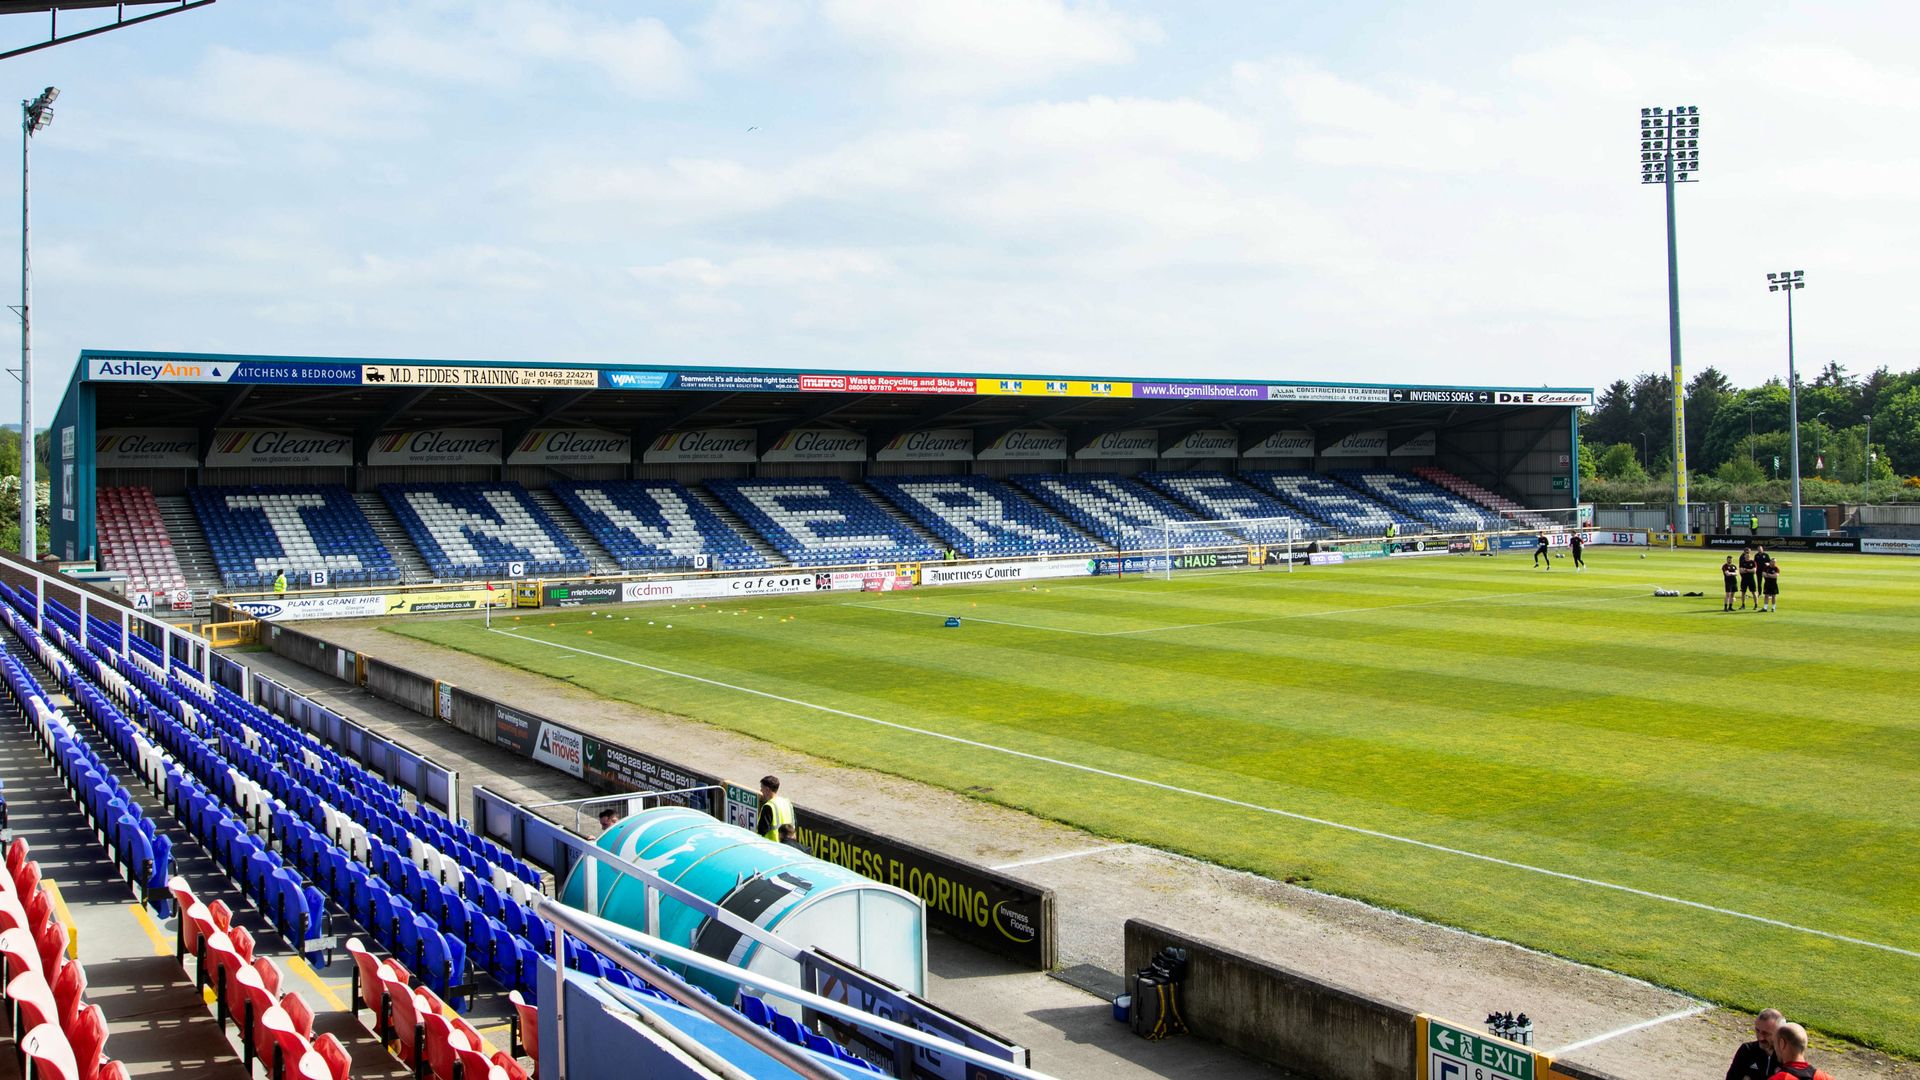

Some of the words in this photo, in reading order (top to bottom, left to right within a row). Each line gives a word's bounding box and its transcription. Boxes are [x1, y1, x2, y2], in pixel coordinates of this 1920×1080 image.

[99, 362, 200, 379] AshleyAnn
[238, 367, 289, 379] KITCHENS
[292, 368, 298, 378] &
[302, 368, 356, 379] BEDROOMS
[389, 368, 413, 383] M.D.
[418, 368, 460, 384] FIDDES
[463, 369, 519, 384] TRAINING
[803, 377, 844, 388] munros
[850, 377, 876, 385] Waste
[878, 378, 918, 387] Recycling
[937, 379, 954, 387] Skip
[1142, 384, 1258, 397] www.kingsmillshotel.com
[1410, 391, 1450, 401] INVERNESS
[1451, 392, 1474, 402] SOFAS
[1501, 394, 1534, 403] D&E
[251, 432, 350, 455] Gleaner
[410, 430, 500, 454] Gleaner
[546, 431, 628, 454] Gleaner
[678, 431, 754, 453] Gleaner
[799, 431, 865, 452] Gleaner
[906, 432, 969, 451] Gleaner
[1004, 432, 1062, 451] Gleaner
[1101, 431, 1154, 450] Gleaner
[1185, 432, 1234, 450] Gleaner
[1264, 432, 1312, 450] Gleaner
[1552, 535, 1568, 545] IBI
[1612, 533, 1633, 543] IBI
[696, 557, 705, 567] D
[1184, 555, 1217, 567] HAUS
[512, 564, 521, 575] C
[985, 567, 1021, 579] Courier
[314, 572, 324, 584] B
[732, 577, 774, 590] cafe
[779, 577, 811, 587] one
[637, 584, 673, 596] cdmm
[137, 594, 148, 606] A
[327, 598, 356, 606] CRANE
[415, 602, 471, 611] printhighland.co.uk
[552, 730, 580, 750] tailormade
[551, 741, 580, 764] moves
[607, 749, 628, 764] 01463
[628, 756, 642, 769] 225
[642, 762, 656, 775] 224
[742, 791, 757, 806] EXIT
[799, 826, 883, 883] NVERNESS
[889, 859, 988, 929] FLOORING
[1000, 905, 1029, 924] Inverness
[1010, 918, 1035, 937] Flooring
[1481, 1043, 1527, 1076] EXIT
[1475, 1068, 1483, 1080] 6
